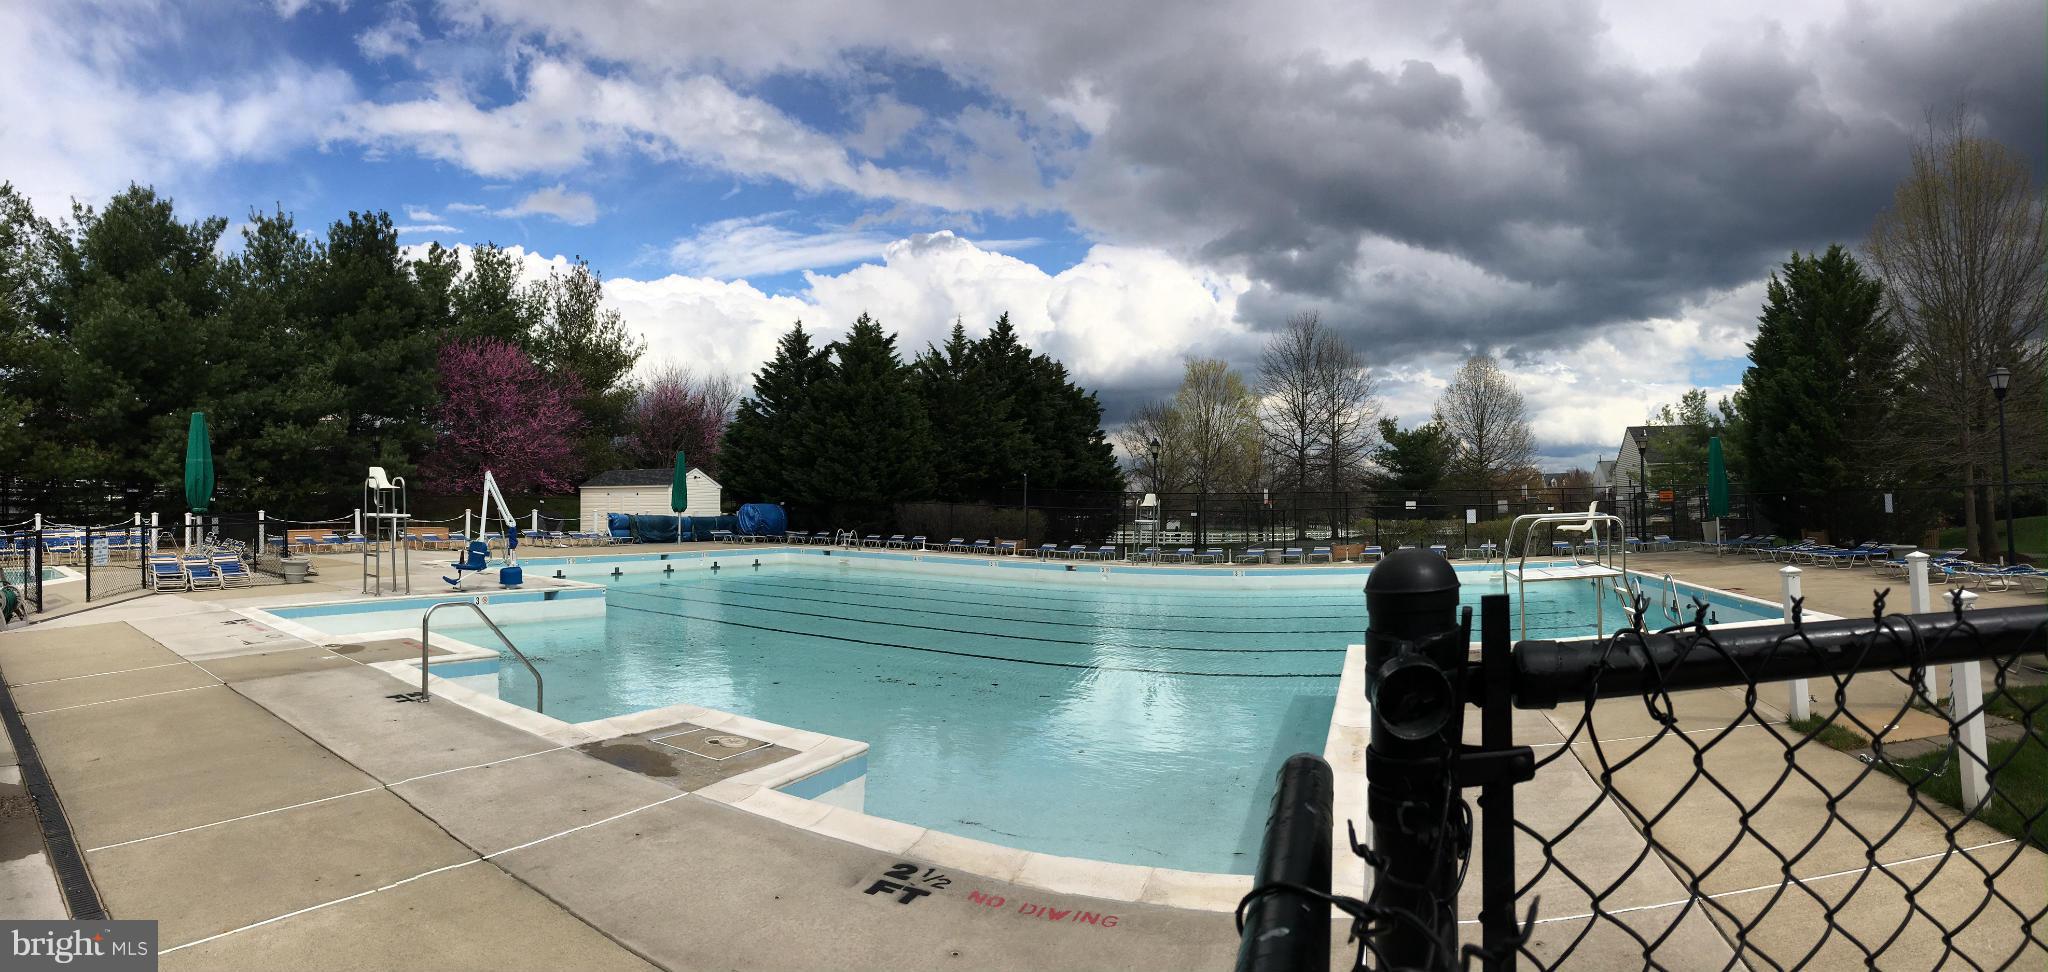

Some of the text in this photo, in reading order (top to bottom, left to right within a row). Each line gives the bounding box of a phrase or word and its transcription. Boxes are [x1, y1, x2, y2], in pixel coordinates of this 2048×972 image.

[883, 863, 919, 880] 2
[863, 879, 932, 905] FT
[967, 889, 1006, 909] NO
